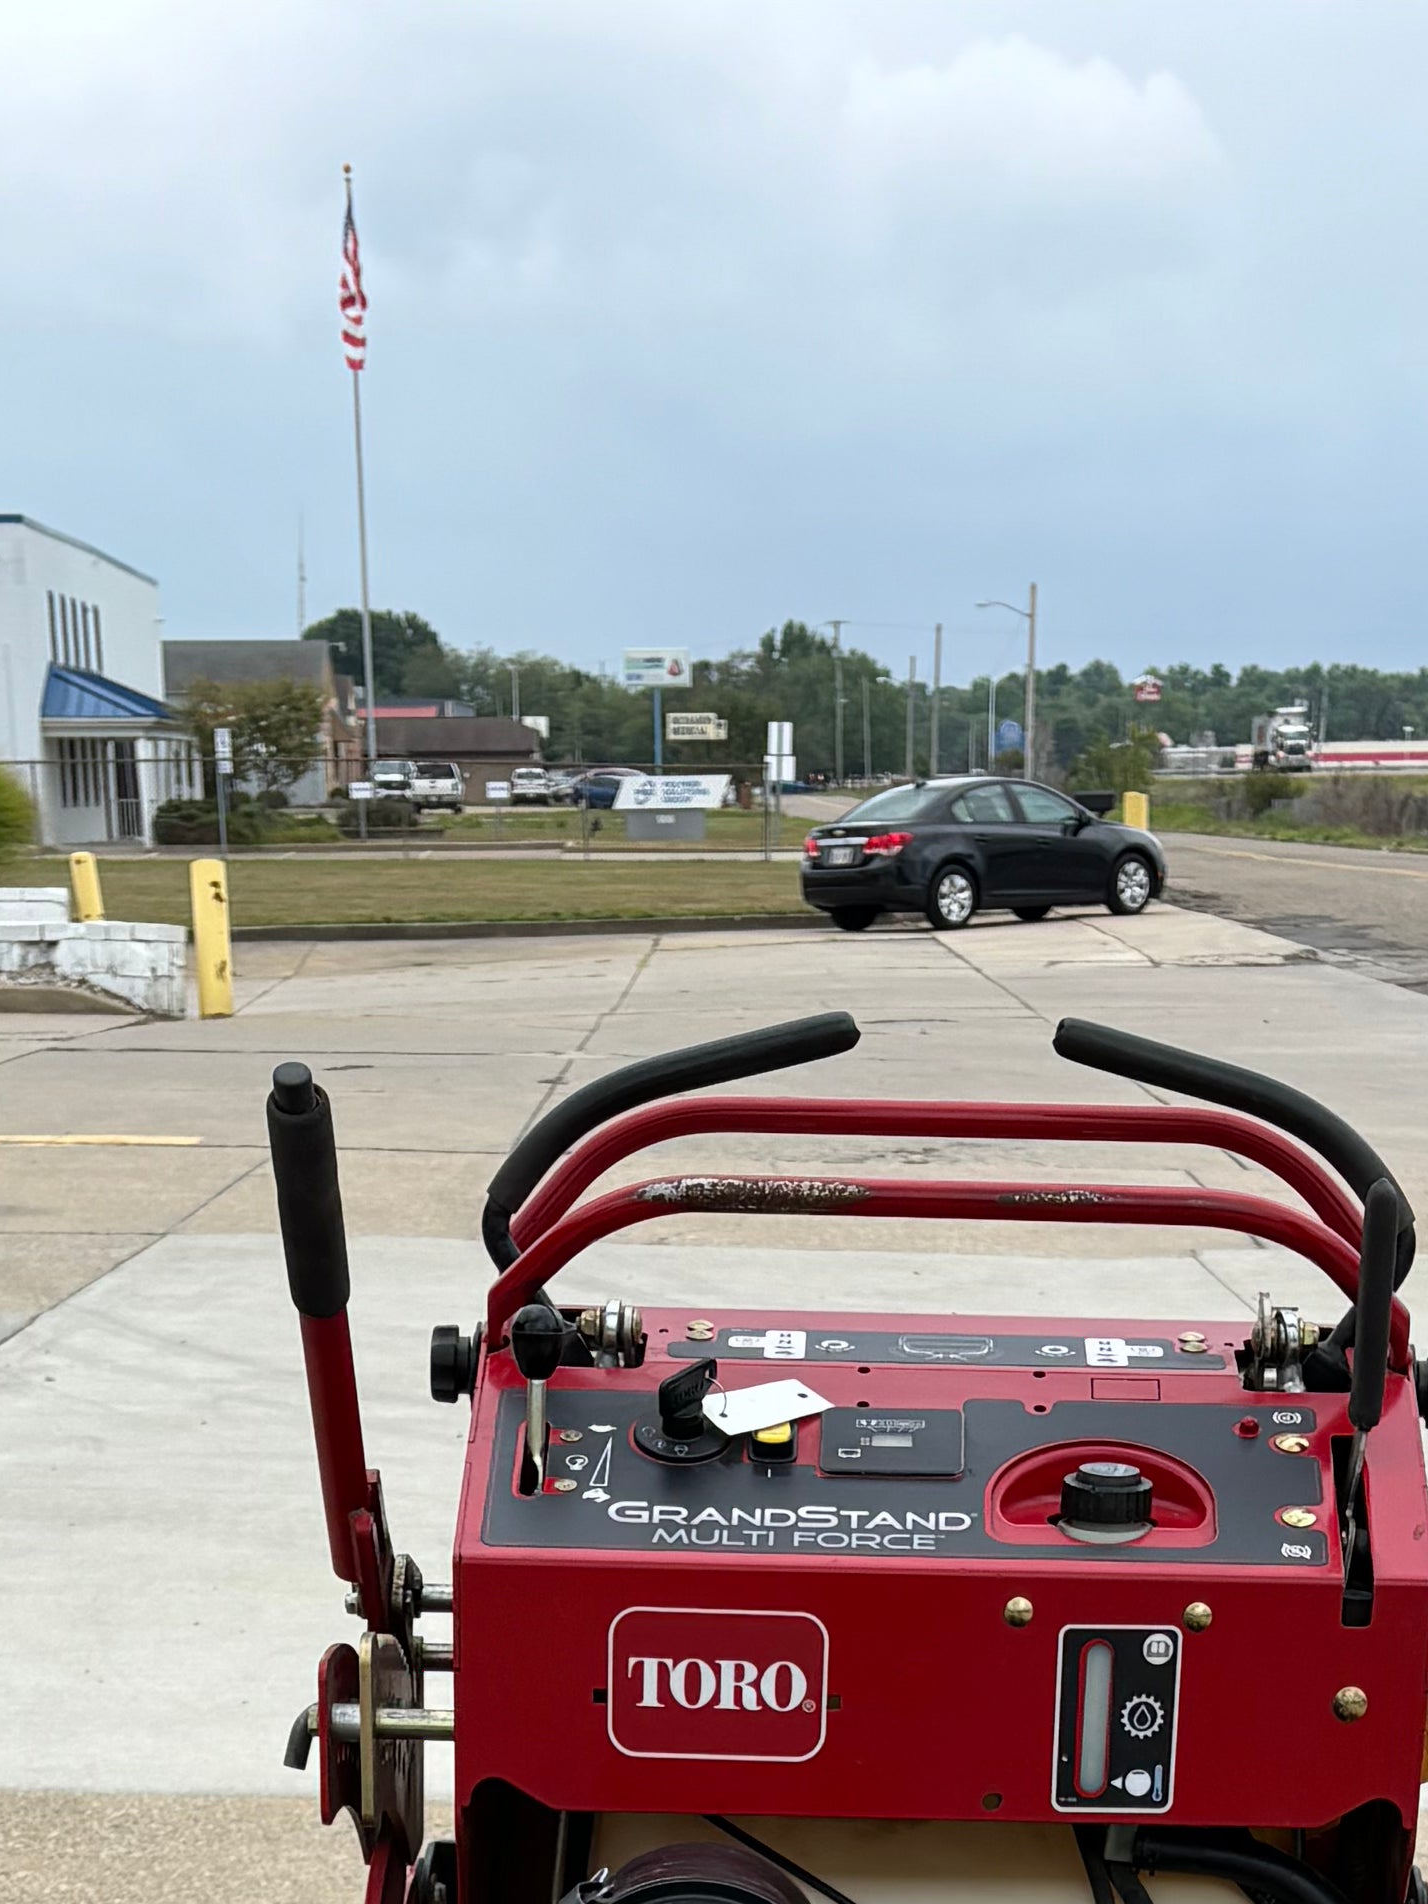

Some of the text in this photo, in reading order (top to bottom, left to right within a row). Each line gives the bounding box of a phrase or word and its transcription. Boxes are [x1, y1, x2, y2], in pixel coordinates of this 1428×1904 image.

[652, 1528, 937, 1550] MULTI FORCE
[628, 1656, 809, 1713] TORO
